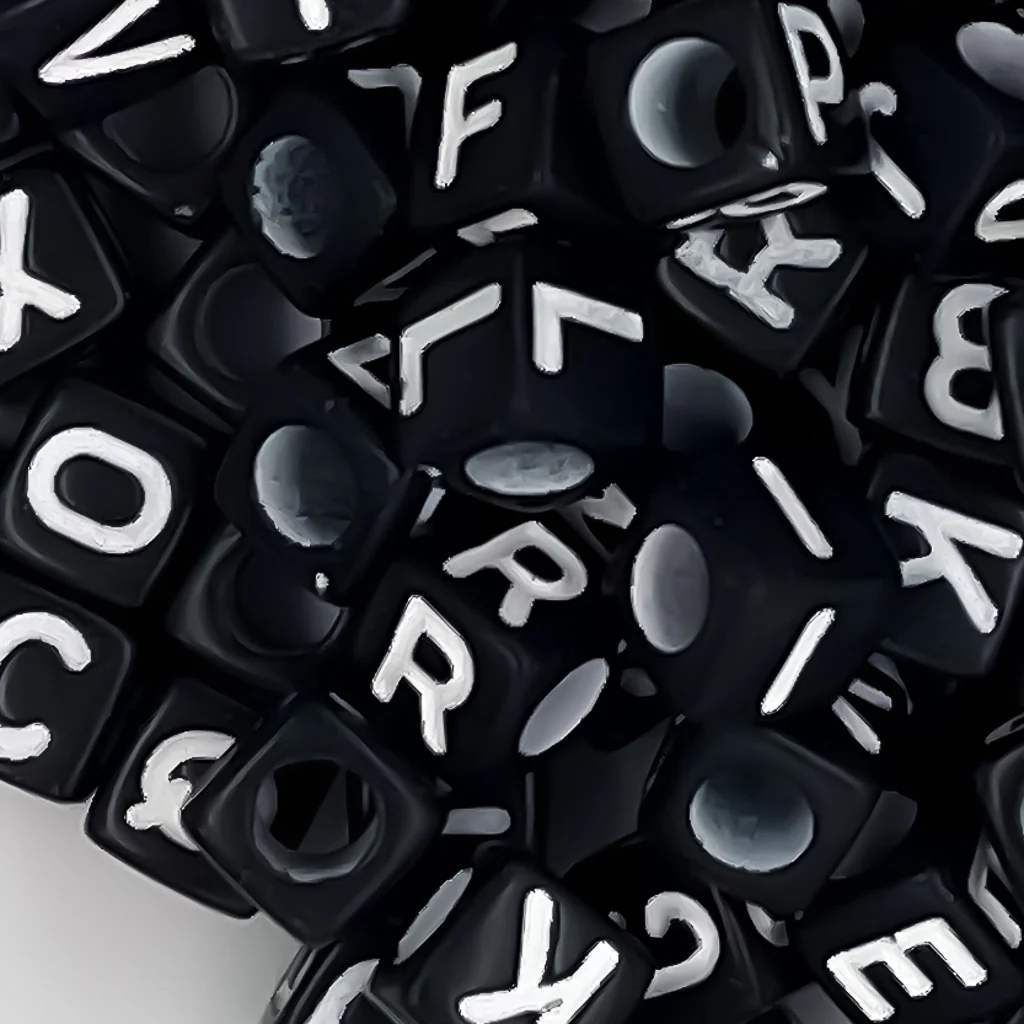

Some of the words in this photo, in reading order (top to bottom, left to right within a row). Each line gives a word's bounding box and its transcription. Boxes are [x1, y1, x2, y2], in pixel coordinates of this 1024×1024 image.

[436, 43, 516, 188] F
[778, 3, 843, 145] P
[27, 428, 171, 553] O
[443, 521, 587, 626] R
[886, 491, 1023, 633] K
[372, 595, 473, 753] R
[827, 918, 987, 1021] E
